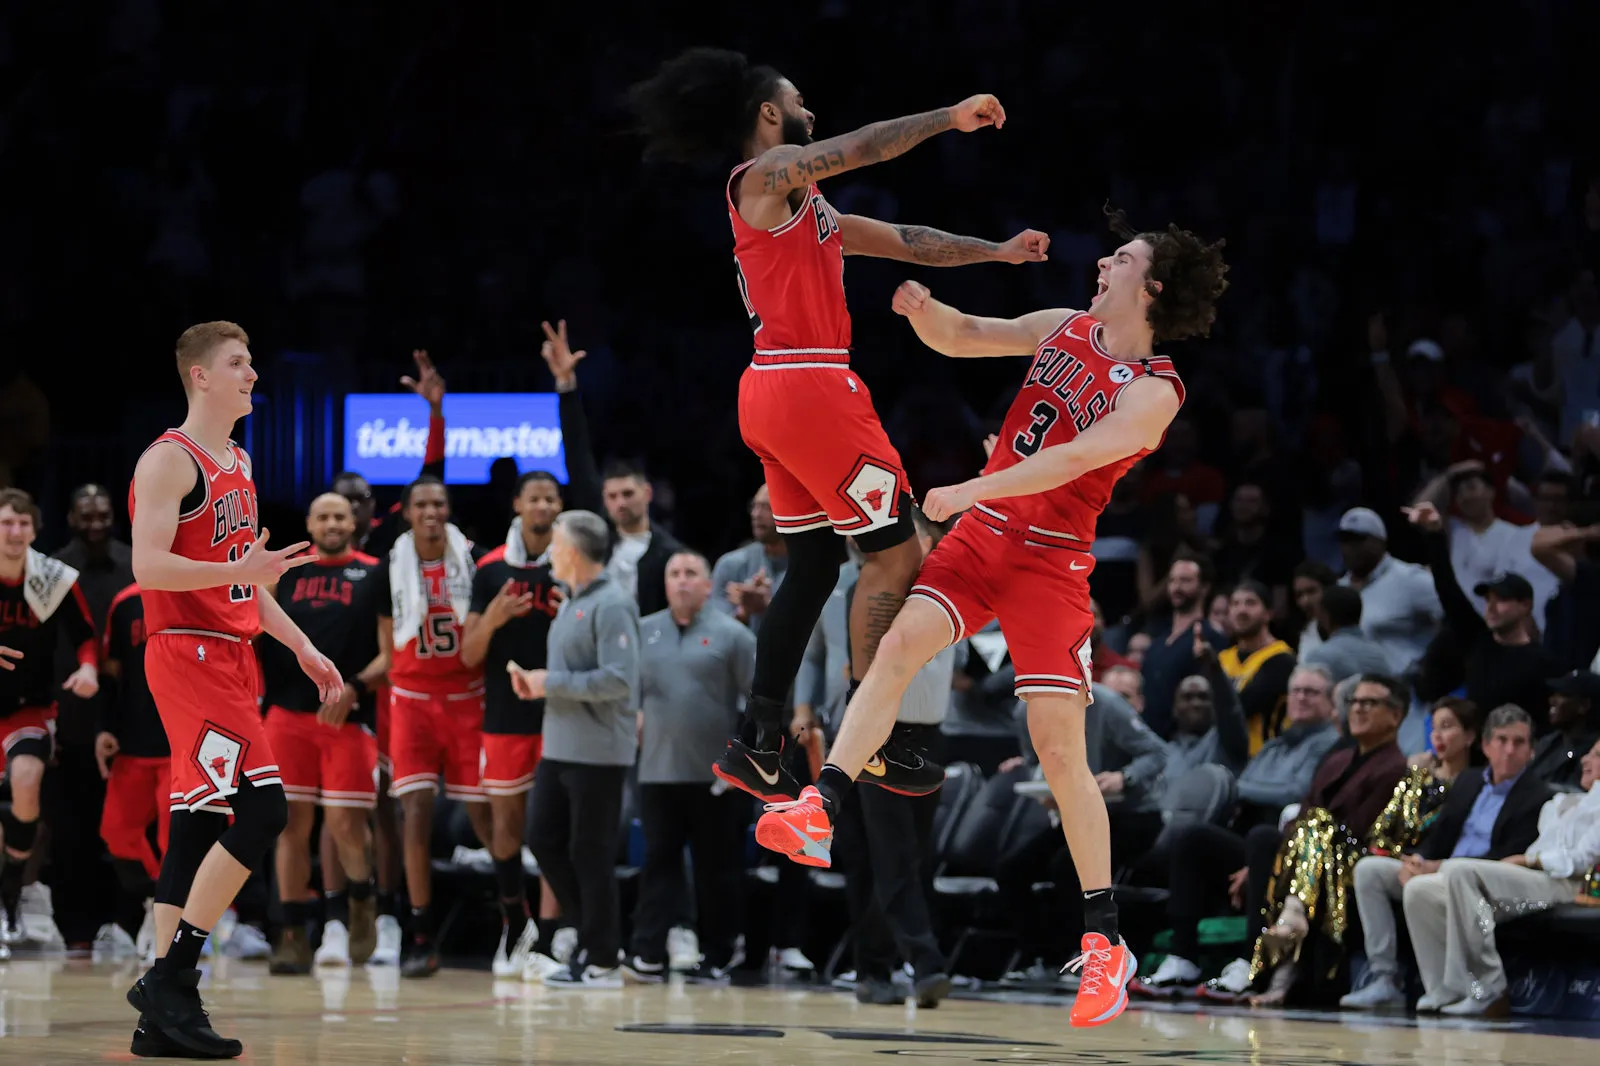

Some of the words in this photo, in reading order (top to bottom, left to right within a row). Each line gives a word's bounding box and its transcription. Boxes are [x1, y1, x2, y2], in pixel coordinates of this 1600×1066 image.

[1023, 346, 1107, 433] BULLS
[1012, 399, 1060, 459] 3
[210, 489, 258, 547] BULL
[292, 576, 354, 606] BULLS
[415, 612, 459, 660] 15
